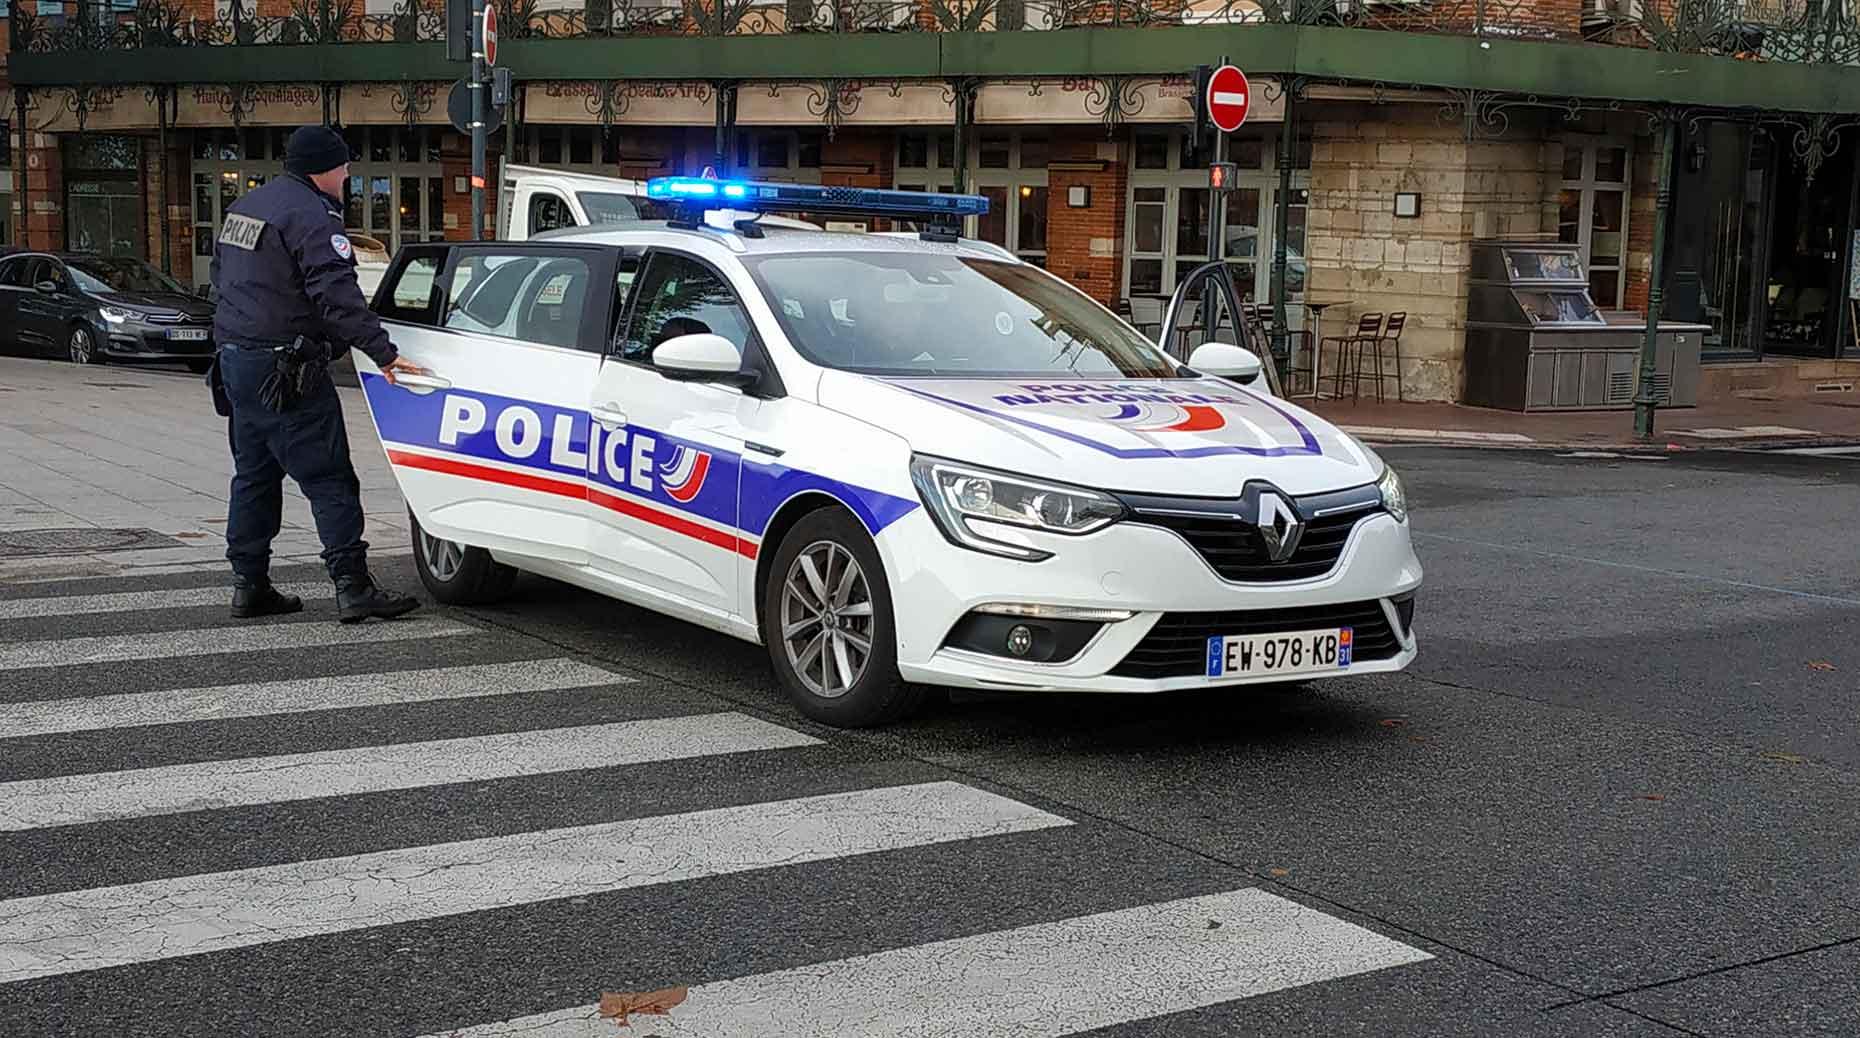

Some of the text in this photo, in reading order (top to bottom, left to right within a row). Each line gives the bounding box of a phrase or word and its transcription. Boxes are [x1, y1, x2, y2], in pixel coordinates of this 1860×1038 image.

[222, 218, 261, 247] POLICE
[993, 394, 1248, 406] NATIONALE
[1018, 384, 1173, 394] POLICE
[438, 393, 656, 492] POLICE
[1225, 635, 1337, 672] EW-978-KB
[1338, 648, 1350, 663] 31
